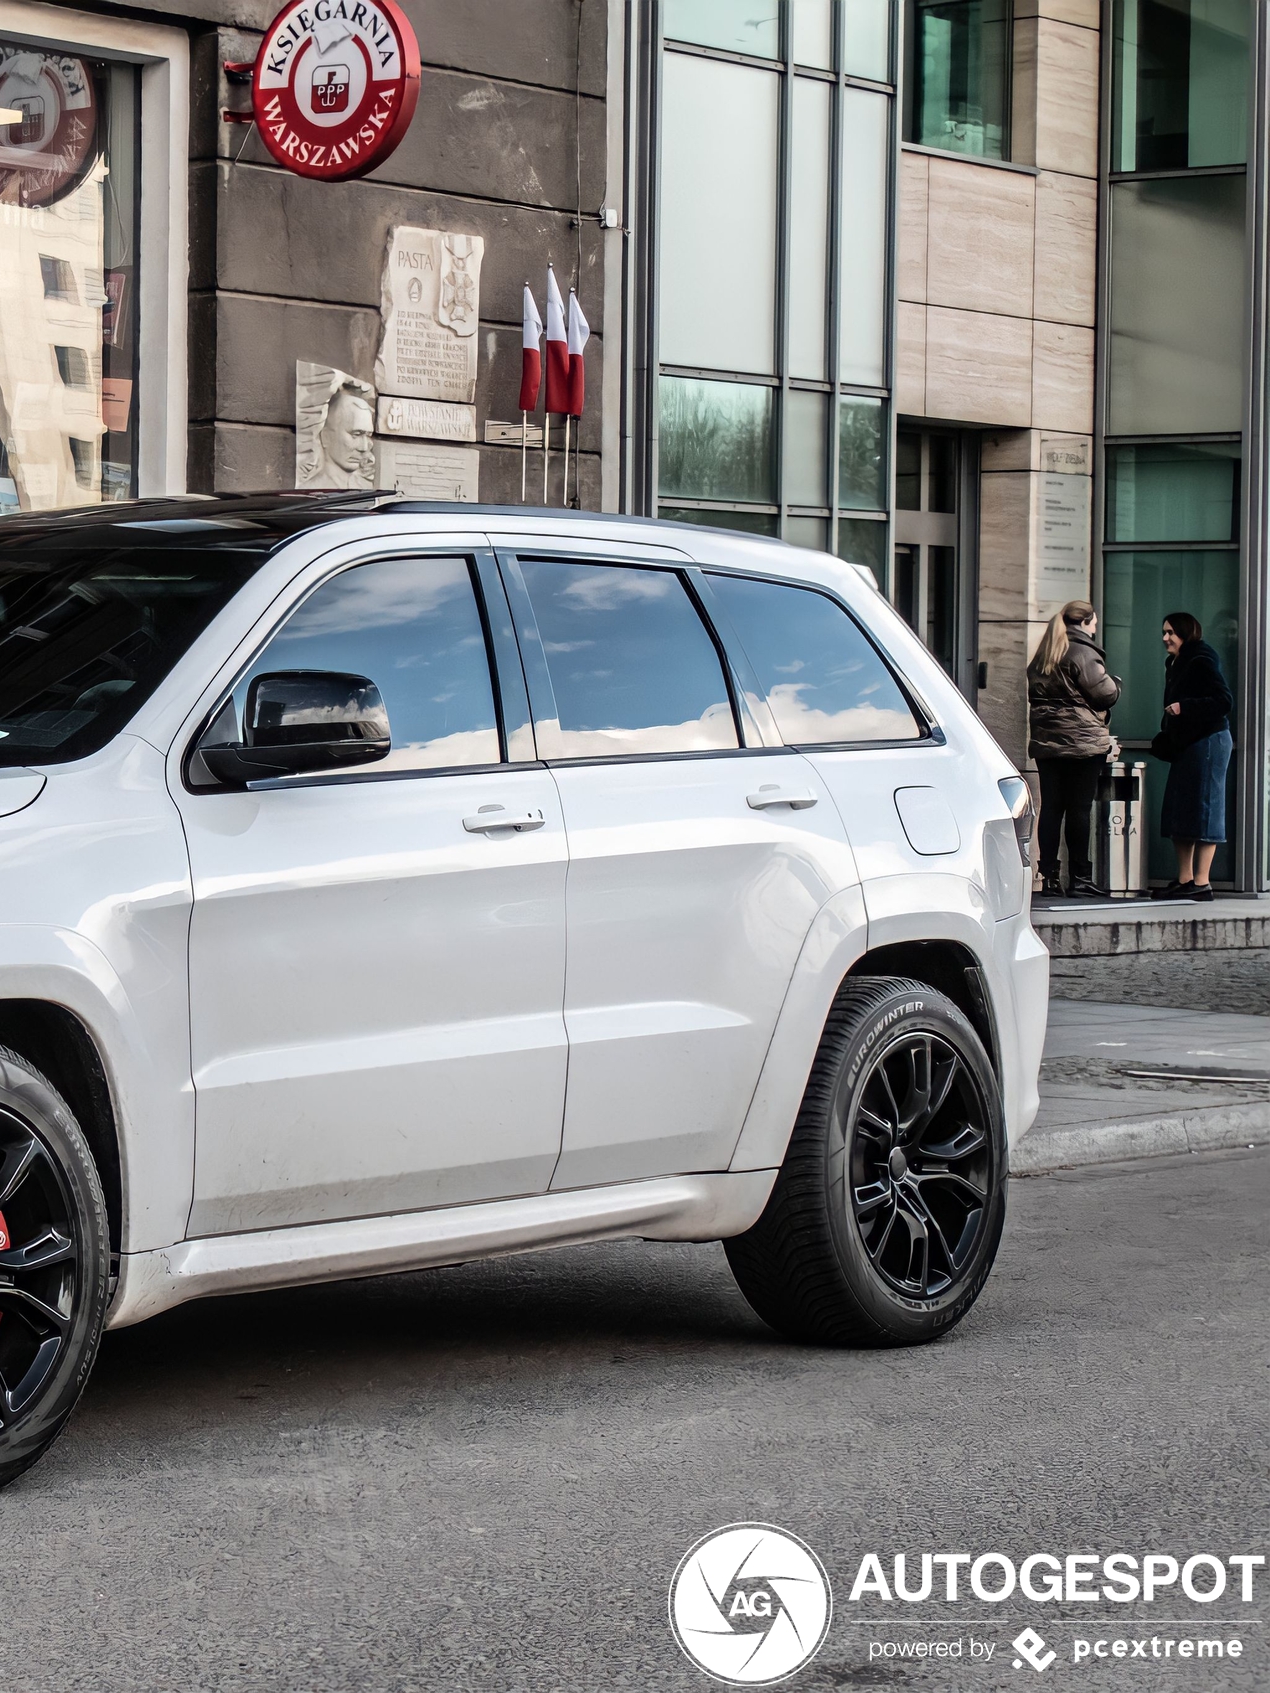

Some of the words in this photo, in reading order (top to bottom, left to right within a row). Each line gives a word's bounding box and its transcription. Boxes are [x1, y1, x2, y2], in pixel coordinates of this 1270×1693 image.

[267, 0, 394, 76] KSIĘGARNIA
[263, 87, 397, 168] WARSZAWSKA
[397, 250, 434, 272] PASTA
